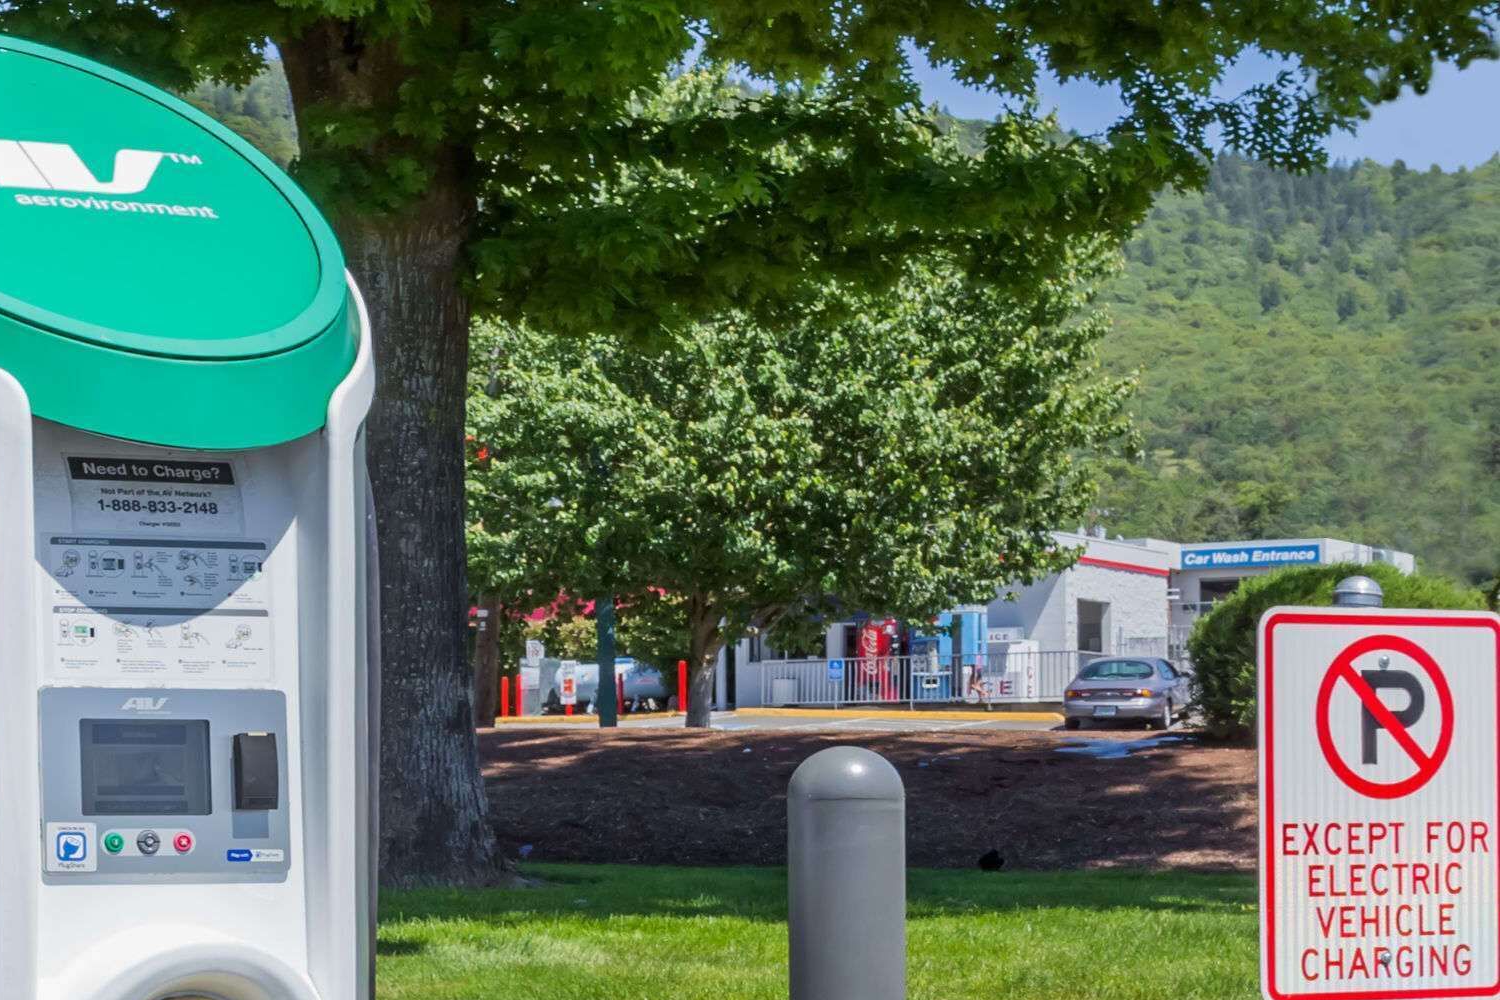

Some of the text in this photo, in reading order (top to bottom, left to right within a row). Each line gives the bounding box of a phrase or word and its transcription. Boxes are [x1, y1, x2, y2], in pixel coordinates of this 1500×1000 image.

[14, 193, 219, 219] aerovironment
[81, 462, 220, 481] Need to Charge?
[97, 499, 218, 514] 1-888-833-2148
[1184, 550, 1316, 565] Car Wash Entrance
[1282, 821, 1489, 856] EXCEPT FOR
[1308, 862, 1463, 897] ELECTRIC
[1316, 903, 1455, 938] VEHICLE
[1301, 944, 1473, 981] CHARGING
